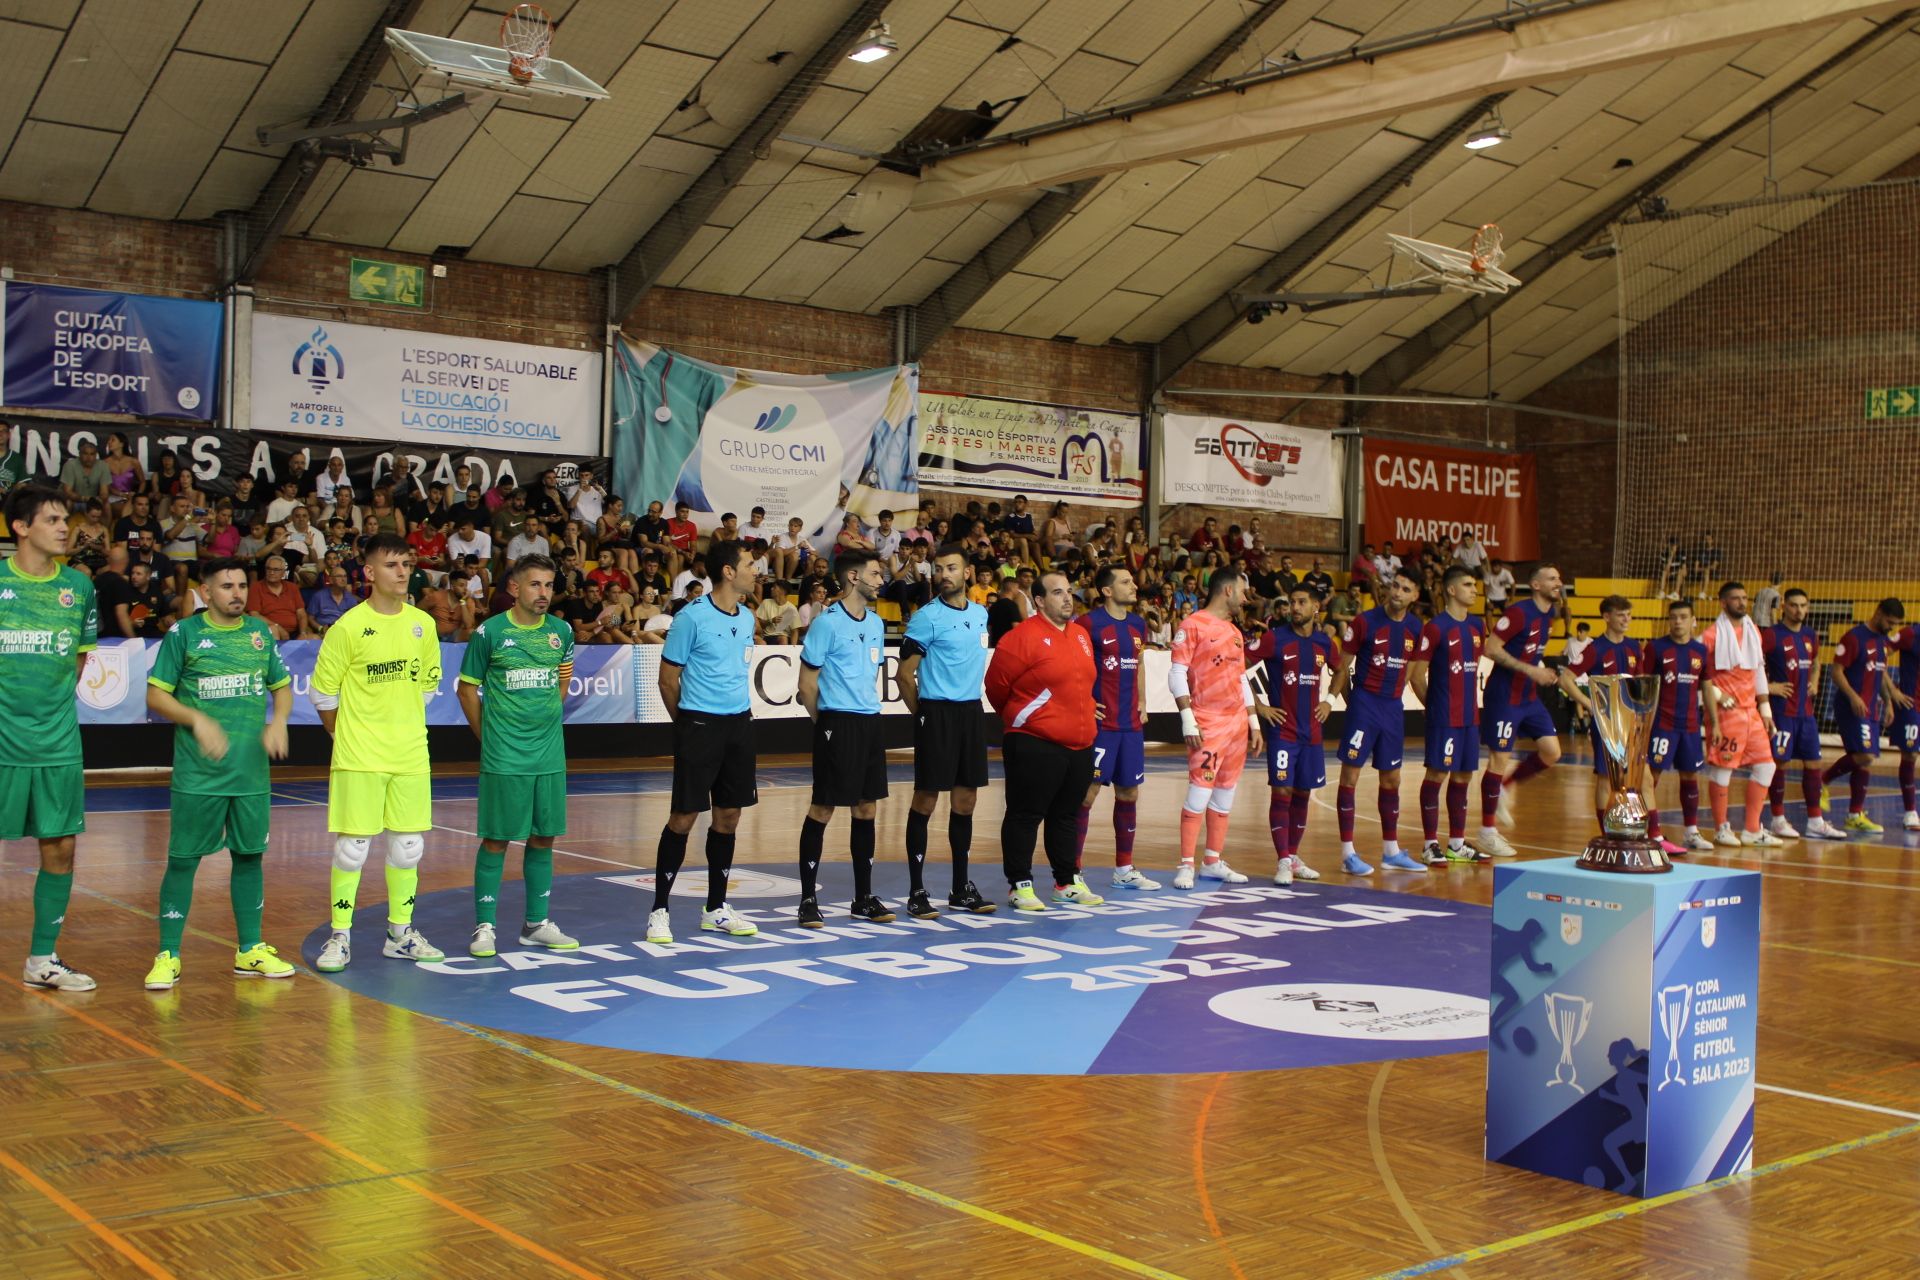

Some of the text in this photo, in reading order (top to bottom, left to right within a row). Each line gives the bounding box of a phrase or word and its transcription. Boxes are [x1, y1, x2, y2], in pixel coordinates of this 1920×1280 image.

[54, 310, 127, 331] CIUTAT
[54, 331, 153, 353] EUROPEA
[54, 351, 82, 368] DE
[402, 348, 578, 381] L'ESPORT SALUDABLE
[54, 370, 150, 392] L'ESPORT
[402, 370, 509, 392] AL SERVEI DE
[290, 401, 345, 413] MARTORELL
[402, 388, 508, 413] L'EDUCACIÓ I
[290, 411, 344, 427] 2023
[402, 411, 561, 440] LA COHESIÓ SOCIAL
[926, 434, 984, 448] PARES
[998, 441, 1057, 456] MARES
[997, 428, 1056, 444] ESPORTIVA
[720, 439, 825, 462] GRUPO CMI
[1007, 453, 1057, 465] MARTORELL
[249, 440, 276, 483] A
[730, 464, 758, 473] CENTRE
[783, 468, 818, 476] INTEGRAL
[1071, 453, 1096, 475] FS
[553, 466, 580, 479] ZER
[917, 473, 936, 483] mails:
[1375, 454, 1522, 498] CASA FELIPE
[1174, 482, 1230, 495] DESCOMPTES
[1266, 489, 1284, 499] Clubs
[0, 644, 36, 653] EGURIDAD
[198, 673, 251, 690] PROVEREST
[505, 669, 551, 684] PROVEREST
[199, 688, 236, 698] SEGURIDAD
[1350, 729, 1365, 749] 4
[1496, 721, 1513, 739] 16
[1776, 731, 1791, 748] 17
[1904, 724, 1919, 740] 10
[1444, 738, 1454, 756] 6
[1652, 736, 1670, 755] 18
[1720, 737, 1738, 753] 26
[1201, 750, 1219, 770] 21
[1276, 750, 1289, 769] 8
[415, 912, 1036, 975] CATALUNYA
[508, 902, 1458, 1014] FUTBOL SALA
[1022, 952, 1293, 992] 2023
[1695, 978, 1720, 996] COPA
[1695, 993, 1747, 1016] CATALUNYA
[1694, 1016, 1728, 1037] SÈNIOR
[1693, 1036, 1736, 1061] FUTBOL
[1692, 1056, 1750, 1086] SALA 2023
